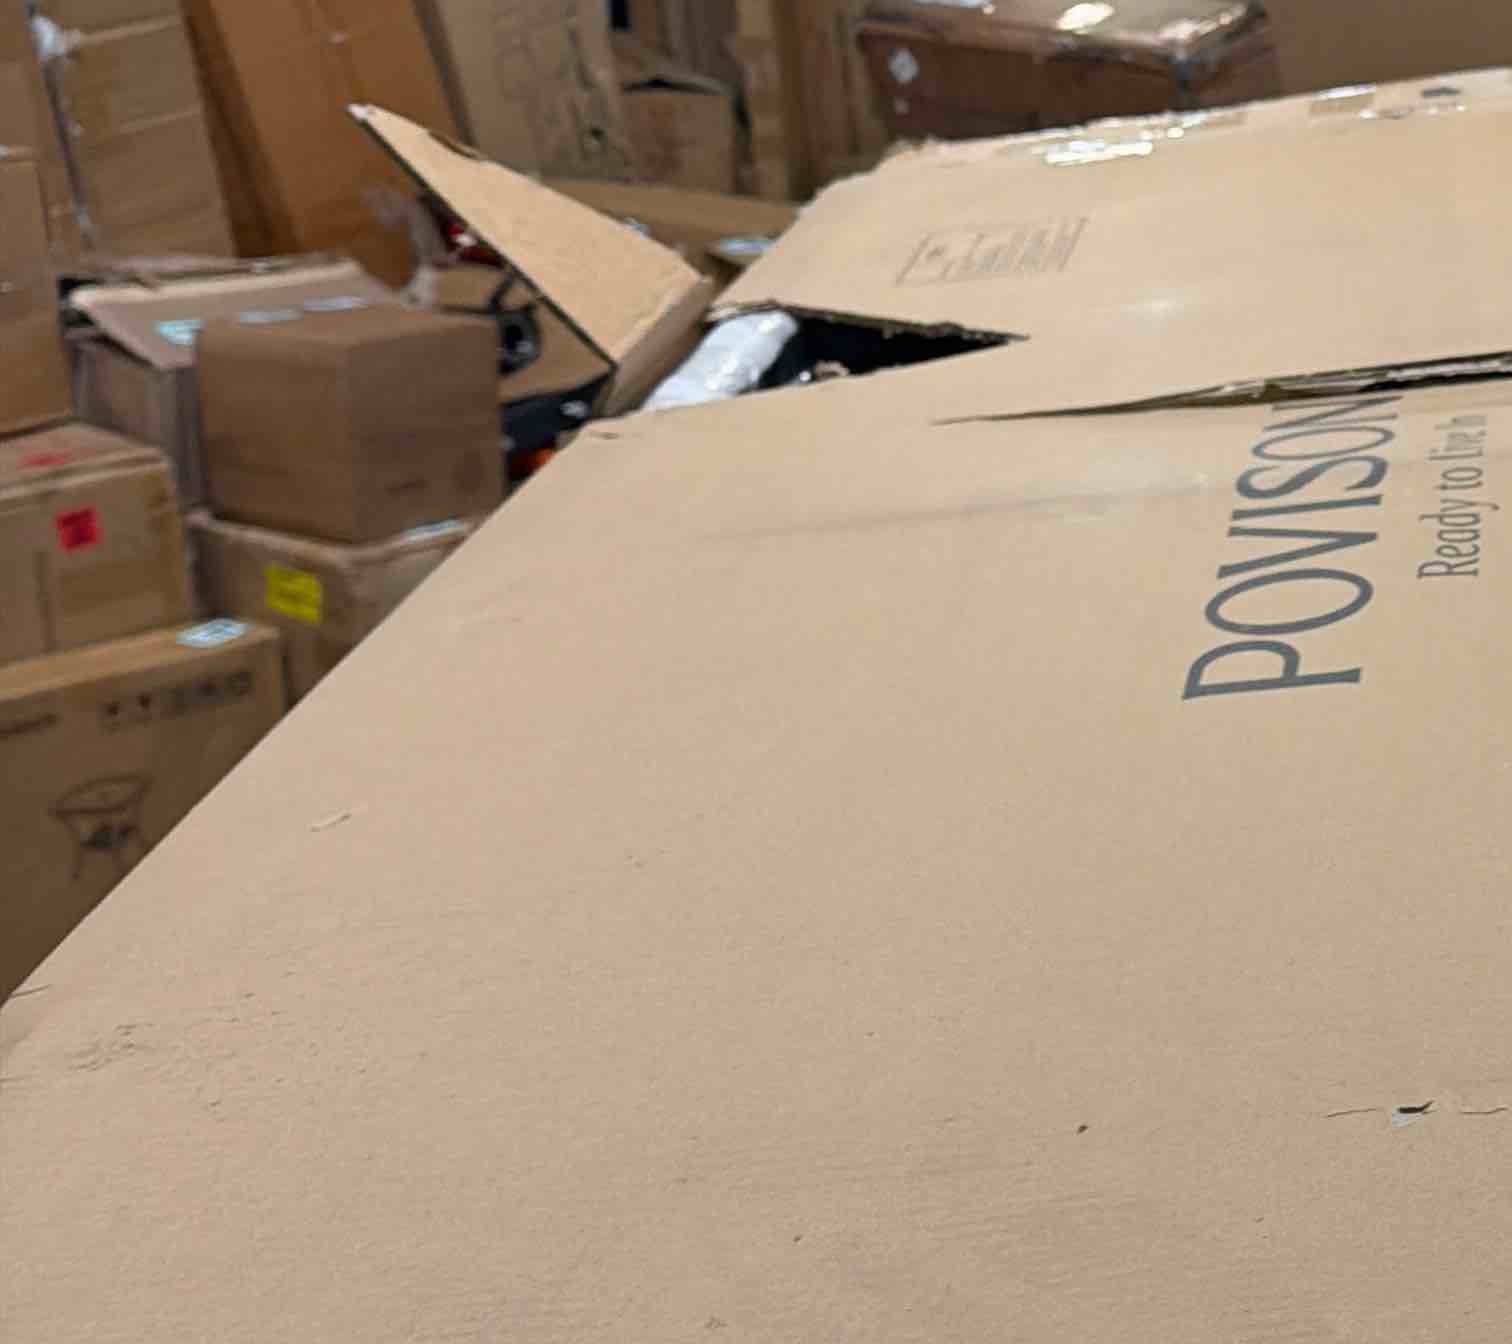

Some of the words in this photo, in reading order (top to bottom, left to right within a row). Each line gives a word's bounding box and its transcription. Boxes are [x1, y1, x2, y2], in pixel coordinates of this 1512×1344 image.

[1434, 466, 1484, 490] to
[1180, 395, 1404, 701] POVISON
[1417, 498, 1500, 579] Ready
